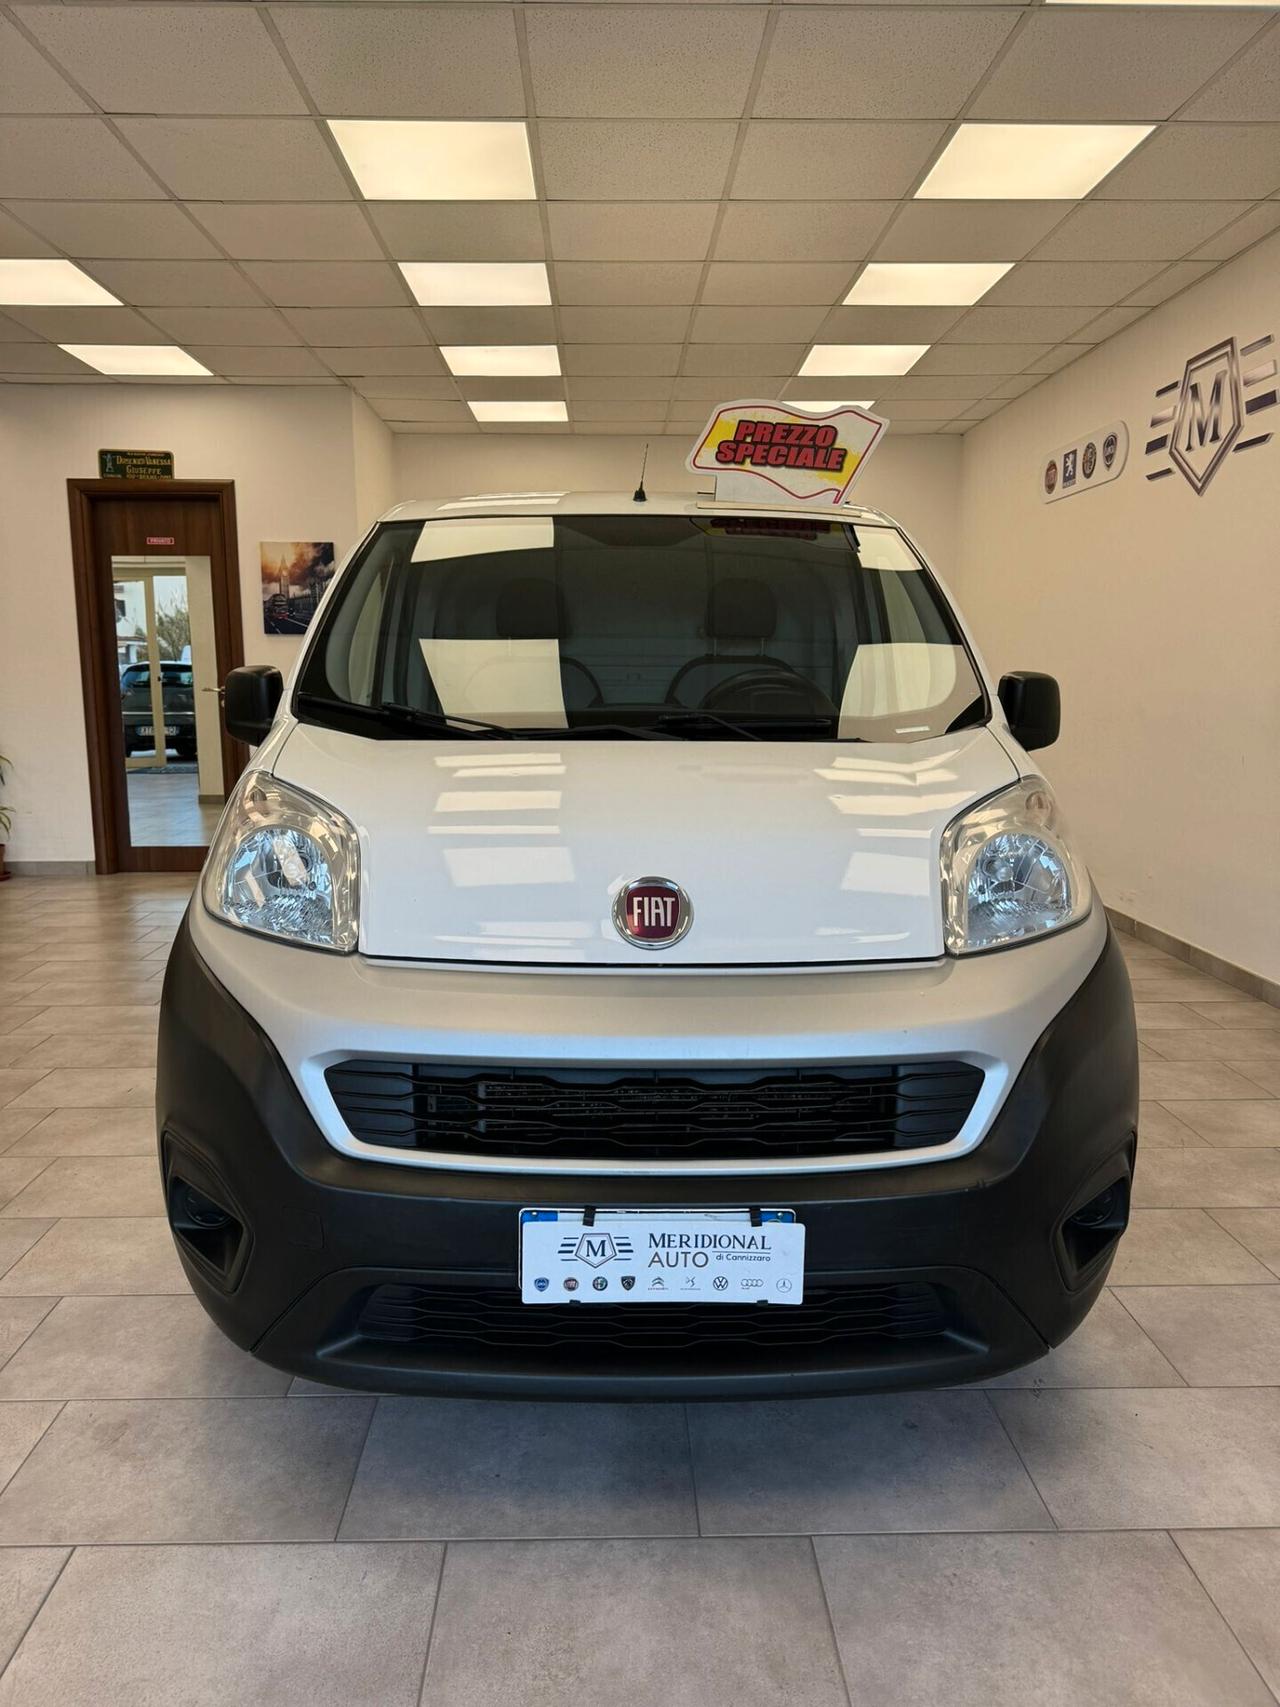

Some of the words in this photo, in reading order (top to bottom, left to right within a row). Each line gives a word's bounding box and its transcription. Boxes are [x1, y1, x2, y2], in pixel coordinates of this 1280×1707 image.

[733, 420, 838, 447] PREZZO
[715, 440, 847, 472] SPECIALE
[632, 896, 676, 927] FIAT
[586, 1239, 607, 1257] M
[648, 1232, 772, 1250] MERIDIONAL
[647, 1251, 709, 1268] AUTO
[715, 1253, 724, 1262] di
[725, 1253, 771, 1262] Cannizzaro
